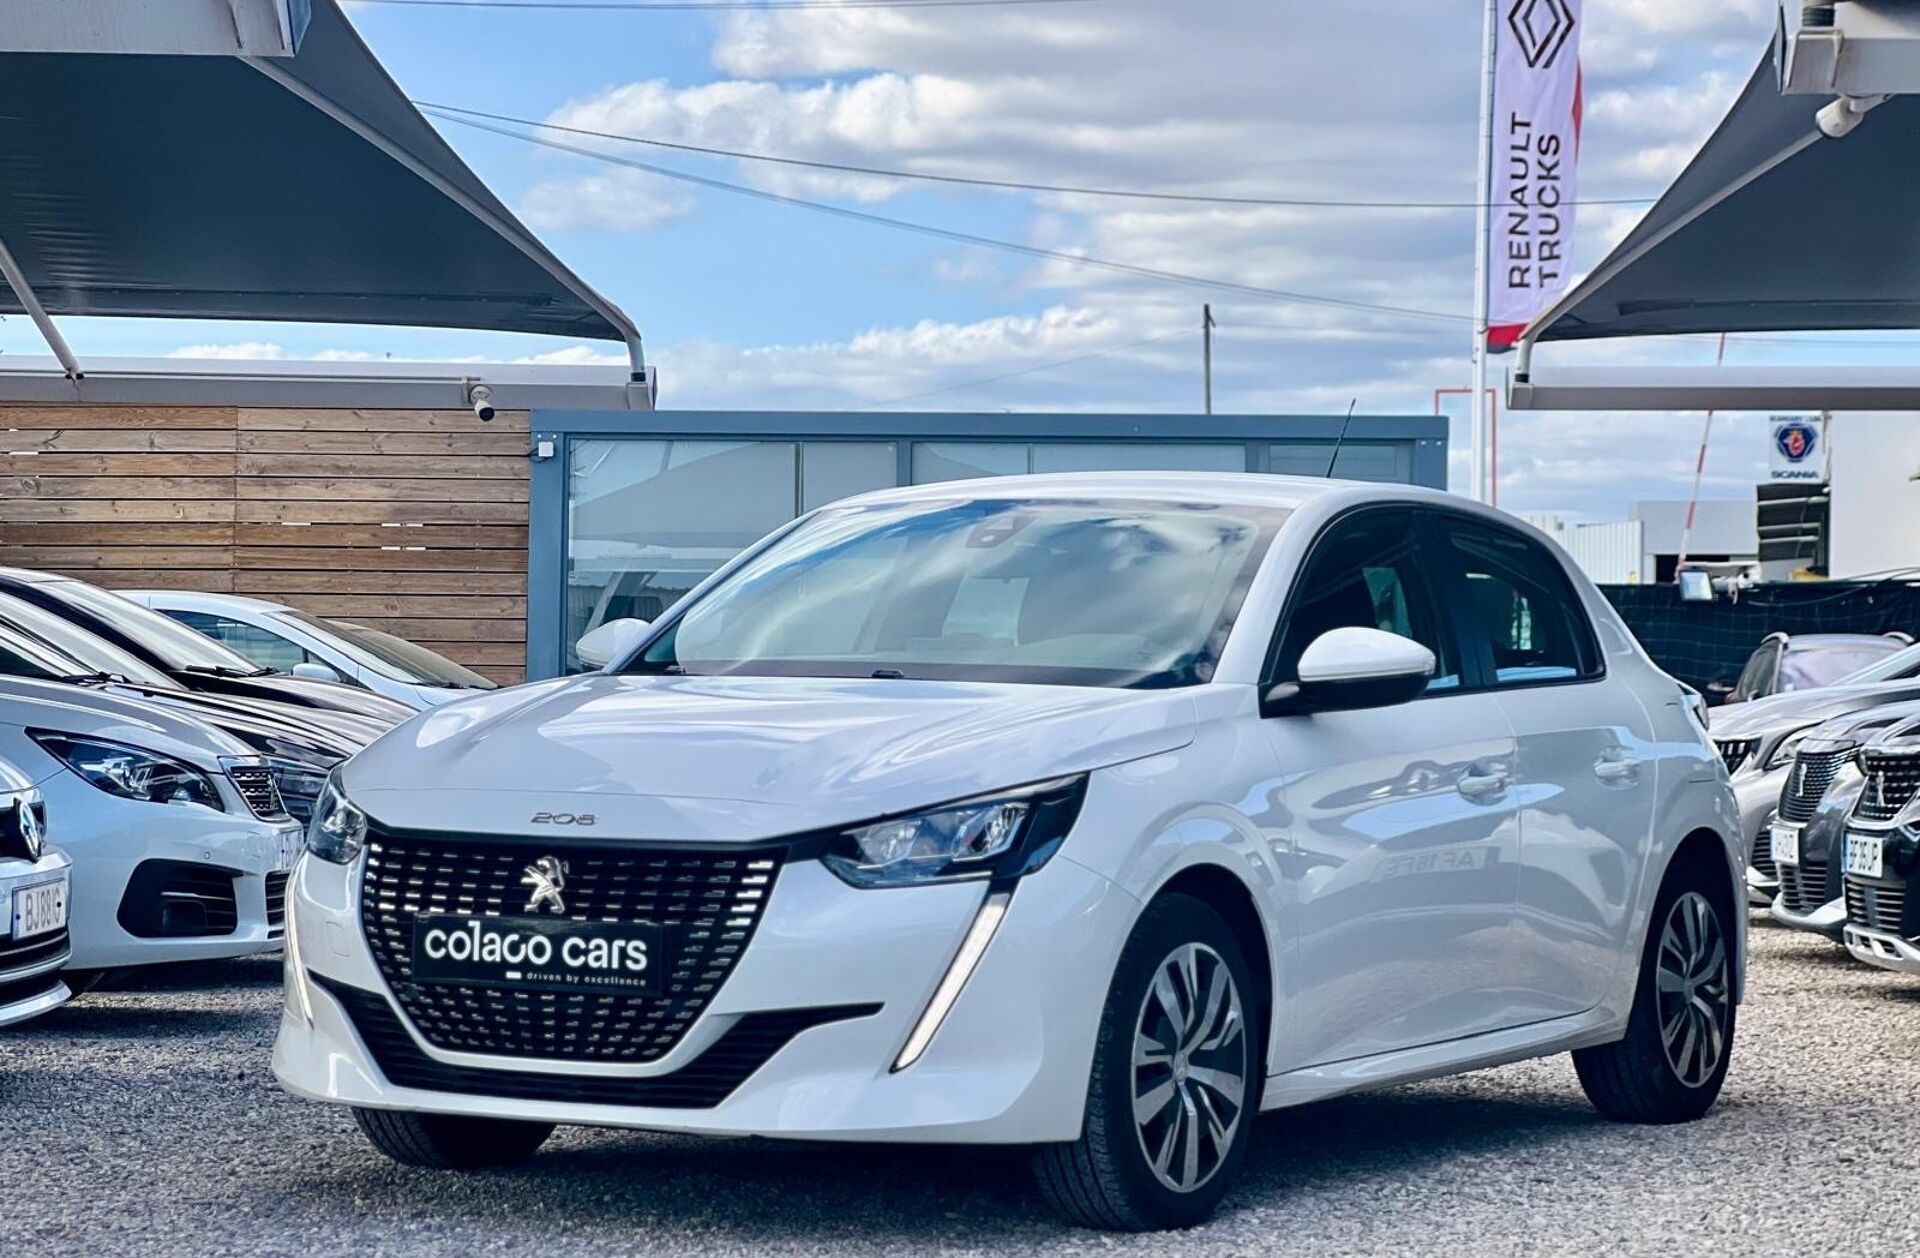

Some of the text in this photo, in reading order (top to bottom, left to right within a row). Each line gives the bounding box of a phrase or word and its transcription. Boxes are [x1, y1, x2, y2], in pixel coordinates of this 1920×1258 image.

[1508, 111, 1532, 289] RENAULT
[1536, 133, 1561, 288] TRUCKS
[1771, 470, 1819, 479] SCANIA
[530, 811, 599, 827] 208
[562, 936, 648, 971] cars
[526, 972, 647, 987] driven by excellence
